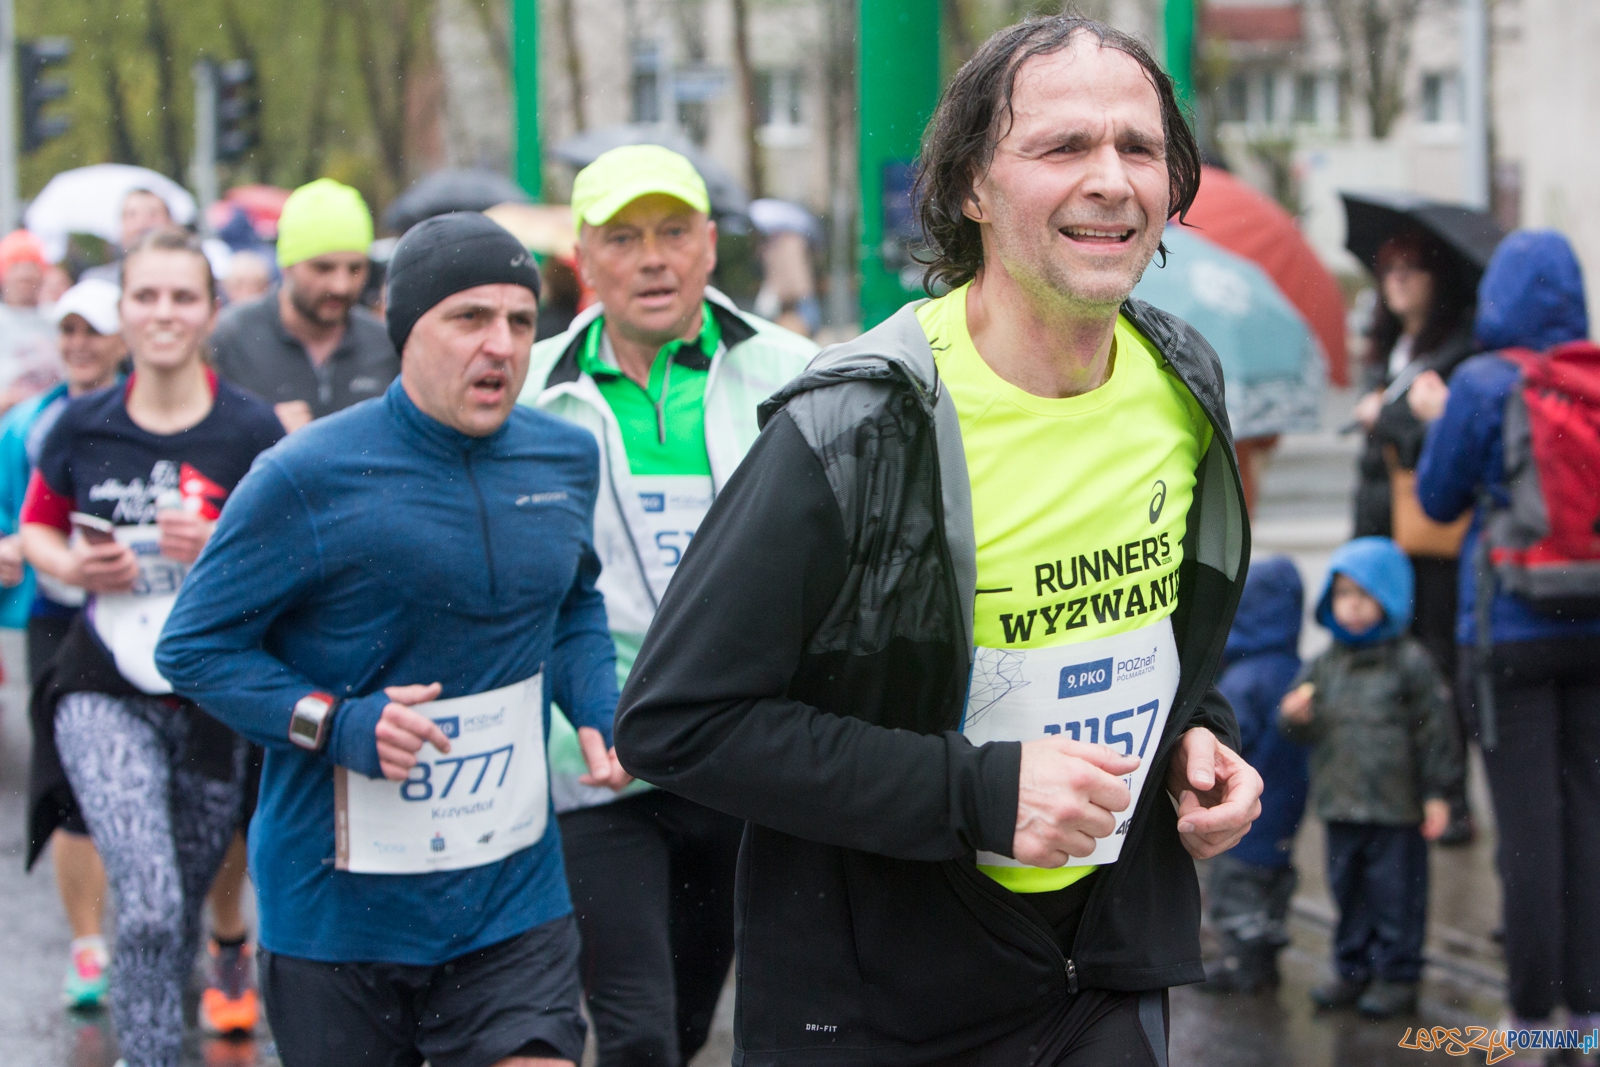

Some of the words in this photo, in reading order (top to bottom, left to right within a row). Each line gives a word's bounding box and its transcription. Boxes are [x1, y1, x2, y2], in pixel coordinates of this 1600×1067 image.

[1035, 531, 1170, 596] RUNNER'S
[1067, 674, 1078, 689] 9.
[1079, 668, 1106, 686] PKO
[400, 744, 514, 802] 8777
[805, 1023, 838, 1033] DRI-FIT
